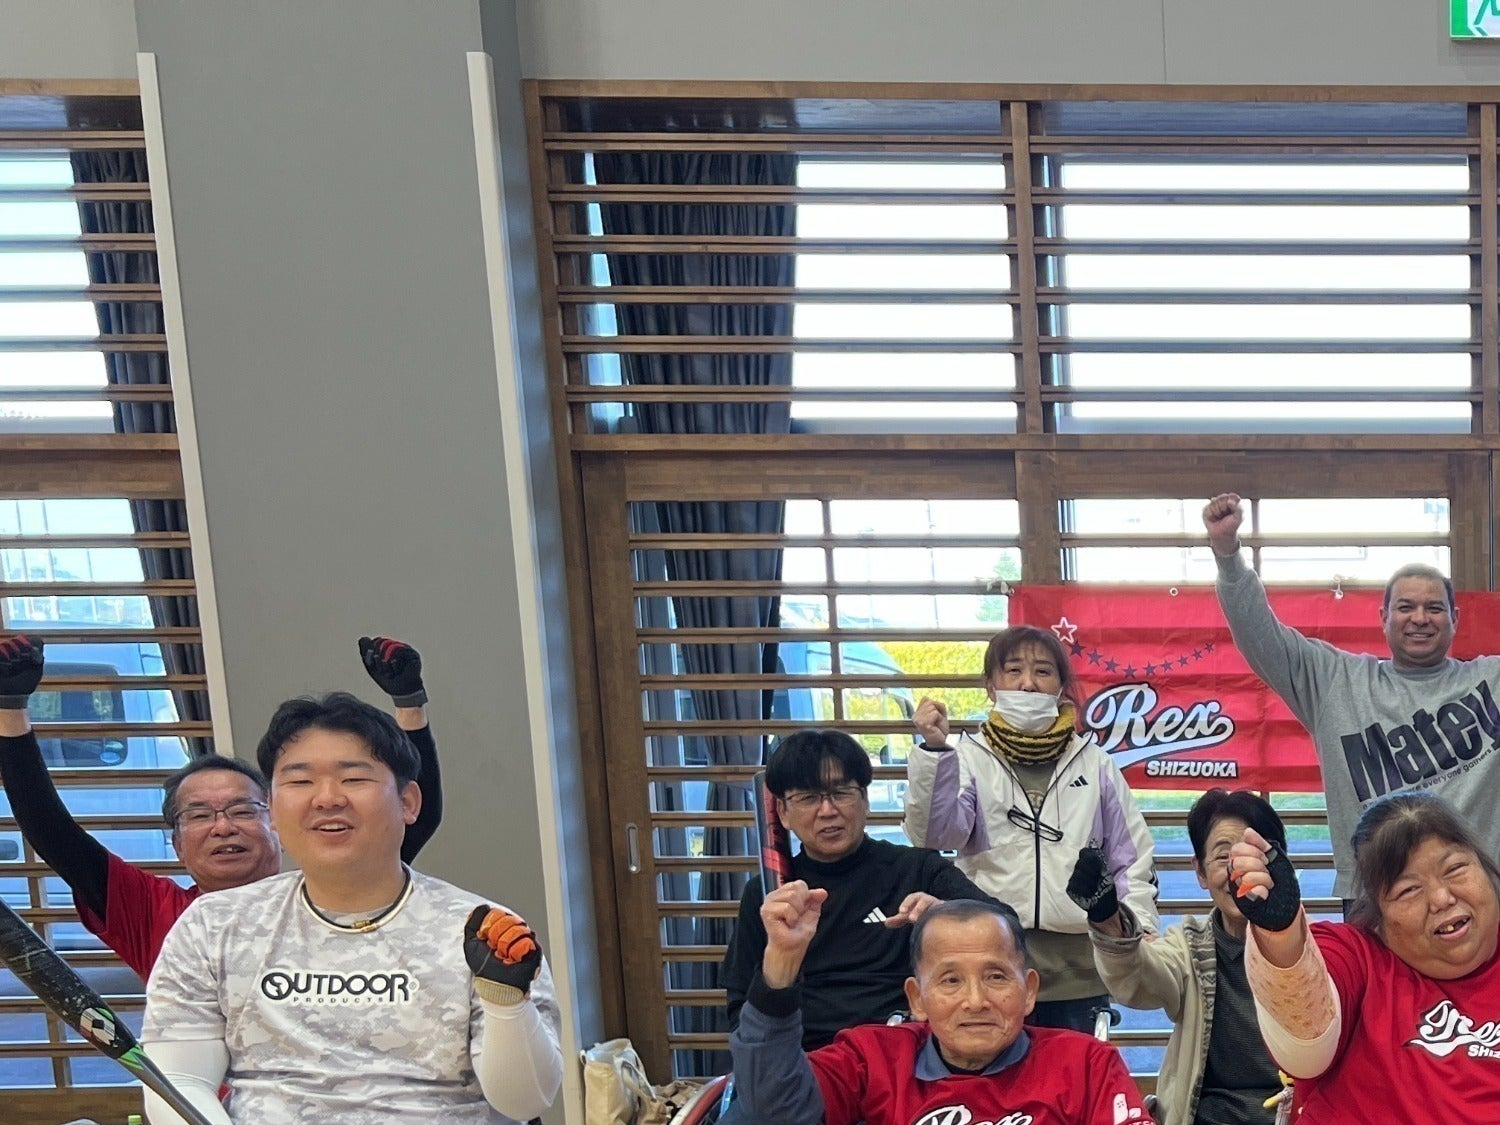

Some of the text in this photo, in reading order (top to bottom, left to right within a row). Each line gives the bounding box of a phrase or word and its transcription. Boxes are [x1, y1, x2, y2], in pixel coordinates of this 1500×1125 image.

[1084, 682, 1235, 754] Rex
[1147, 760, 1237, 777] SHIZUOKA
[1422, 767, 1462, 789] everyone
[1463, 748, 1492, 773] gathers
[261, 972, 409, 1002] OUTDOOR
